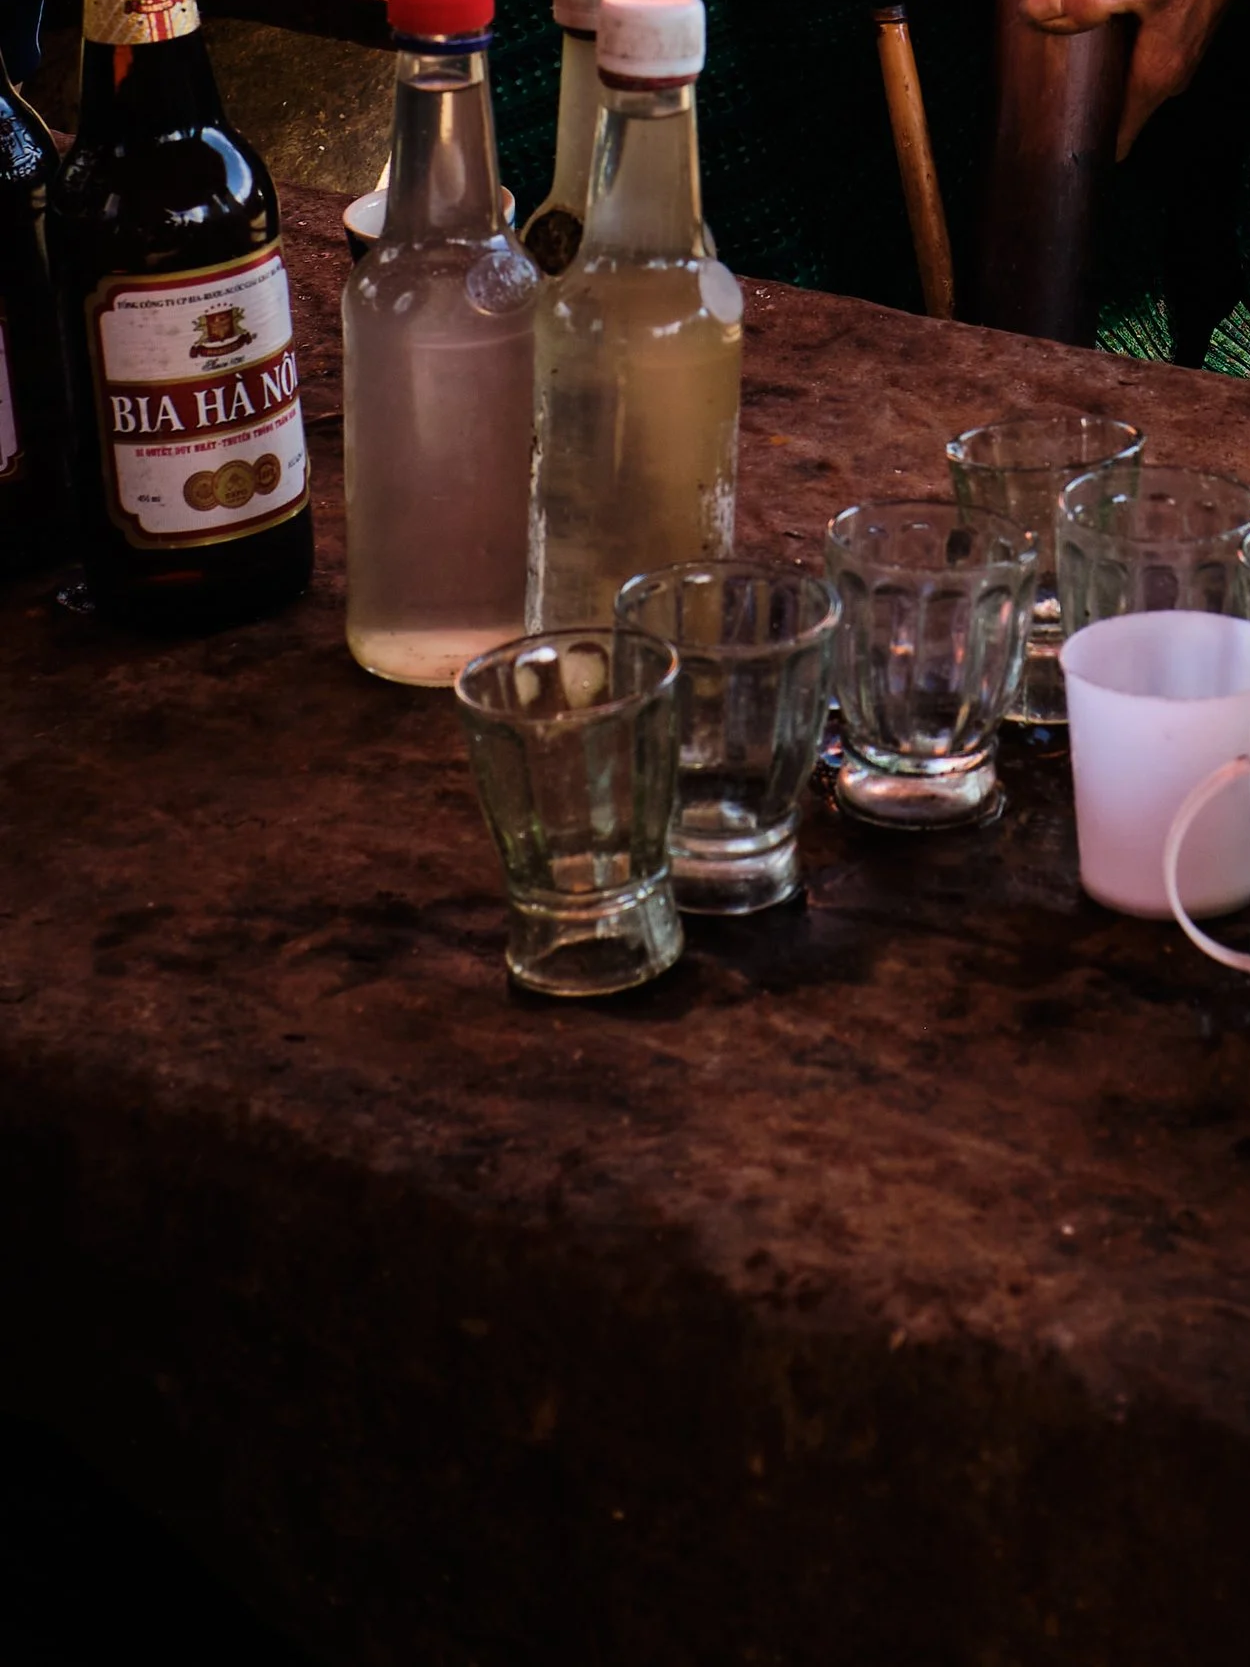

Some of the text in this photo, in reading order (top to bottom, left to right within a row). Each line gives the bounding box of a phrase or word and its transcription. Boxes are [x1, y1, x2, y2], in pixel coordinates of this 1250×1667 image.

[110, 351, 298, 433] BIA HÀ NỘI
[175, 446, 191, 455] DUY
